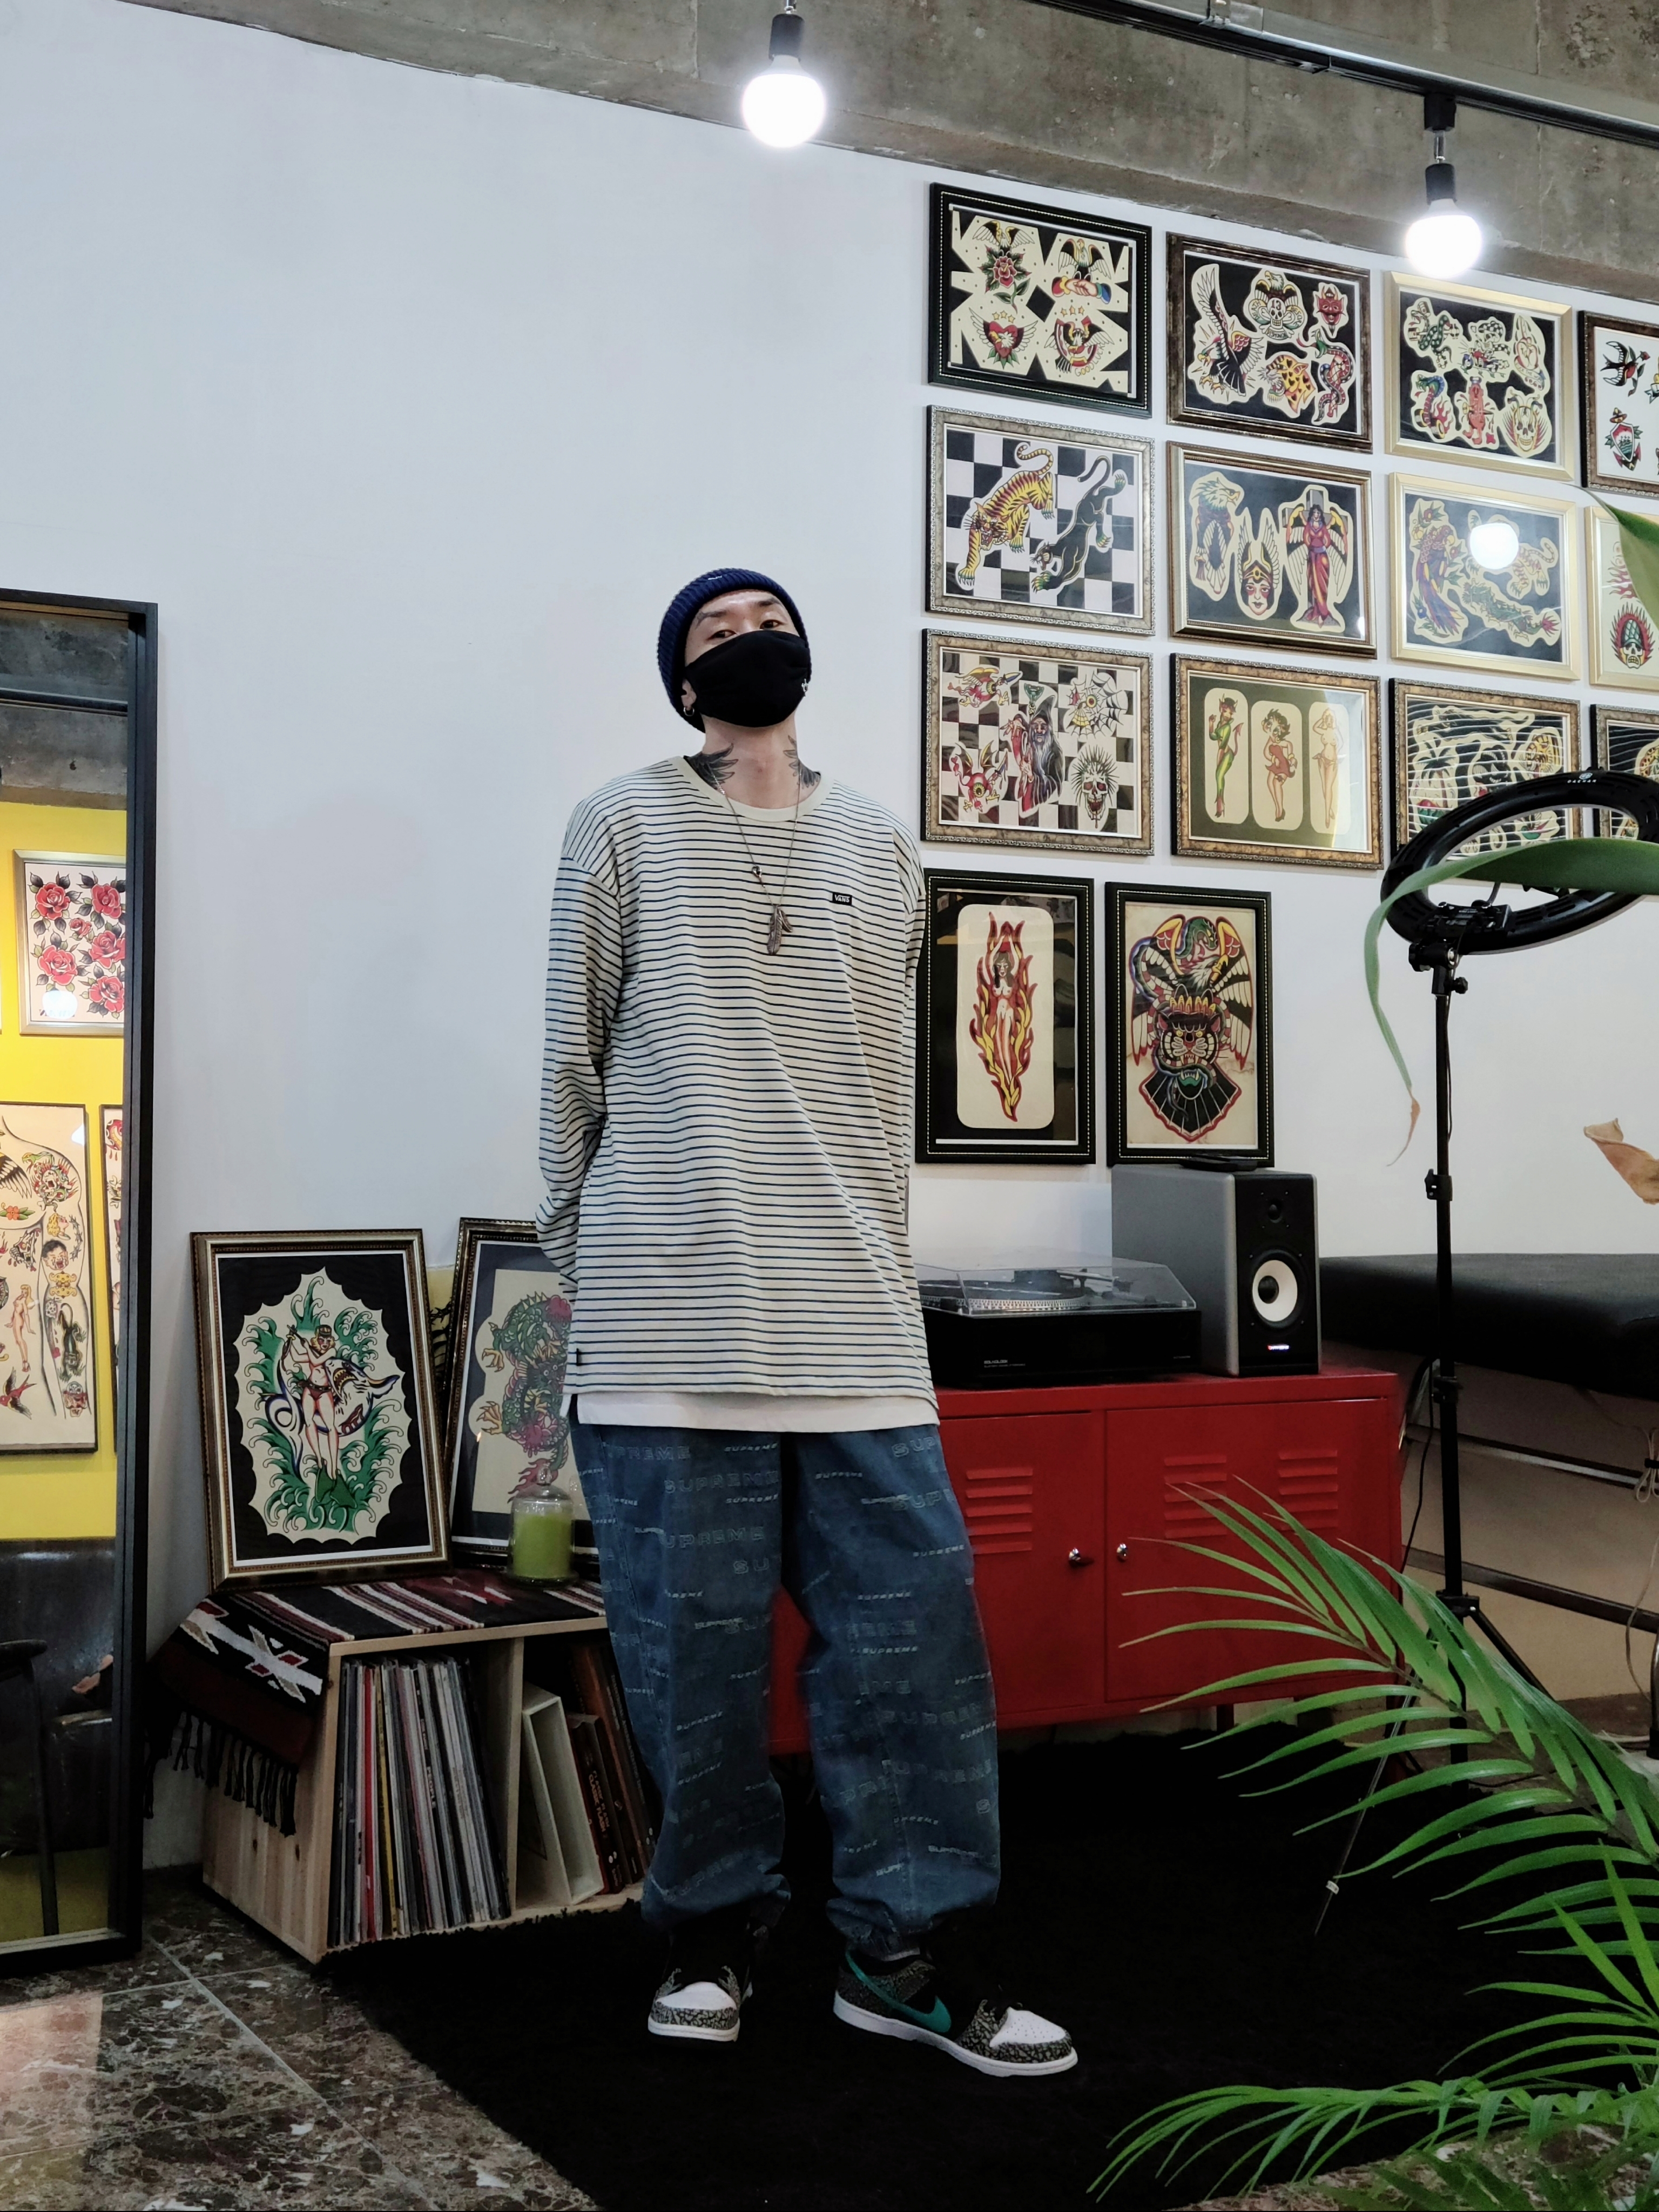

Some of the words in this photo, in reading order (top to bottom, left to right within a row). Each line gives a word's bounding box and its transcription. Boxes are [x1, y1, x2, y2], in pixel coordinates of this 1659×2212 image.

[1271, 300, 1282, 311] 13
[1075, 362, 1095, 377] GOOD
[1091, 345, 1105, 365] LUCK
[834, 894, 850, 903] VANS
[724, 1442, 779, 1452] SUPREME
[664, 1470, 779, 1494] SUPREME
[725, 1493, 779, 1504] SUPREME
[663, 1526, 764, 1549] UPREME
[913, 1543, 965, 1557] SUPREME
[857, 1590, 912, 1600] SUPREME
[862, 1646, 919, 1655] SUPREME
